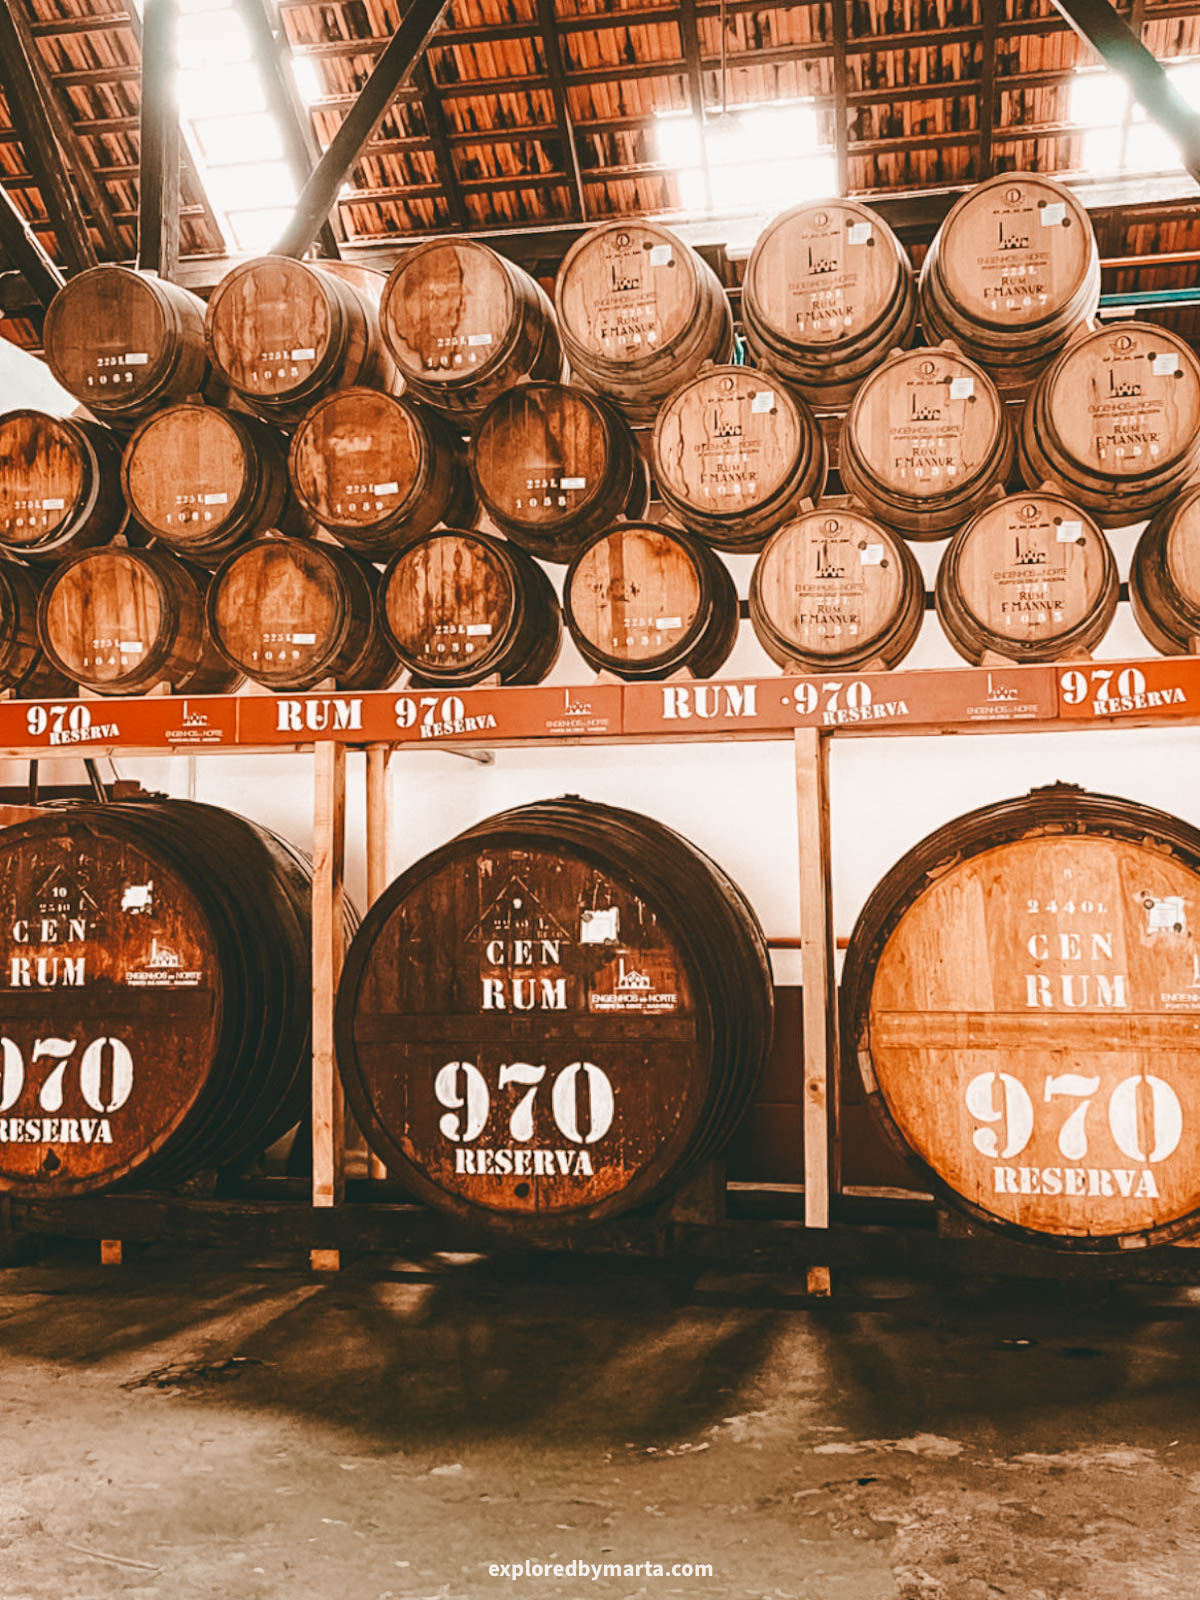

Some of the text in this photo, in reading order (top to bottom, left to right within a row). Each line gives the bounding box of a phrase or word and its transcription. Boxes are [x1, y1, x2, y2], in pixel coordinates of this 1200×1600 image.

[87, 372, 134, 386] 1062
[526, 478, 558, 489] 225L
[5, 515, 47, 528] 1061
[263, 633, 292, 643] 225L
[435, 625, 465, 635] 225L
[661, 681, 872, 719] RUM 970
[1060, 667, 1146, 704] 970
[276, 696, 465, 731] RUM 970
[822, 700, 909, 726] RESERVA
[1093, 687, 1187, 715] RESERVA
[26, 705, 91, 736] 970
[49, 723, 120, 745] RESERVA
[419, 714, 497, 738] RESERVA
[9, 957, 86, 987] RUM
[481, 978, 568, 1010] RUM
[1025, 974, 1128, 1008] RUM
[434, 1061, 615, 1144] 970
[965, 1072, 1183, 1163] 970
[455, 1149, 594, 1176] RESERVA
[993, 1166, 1160, 1198] RESERVA
